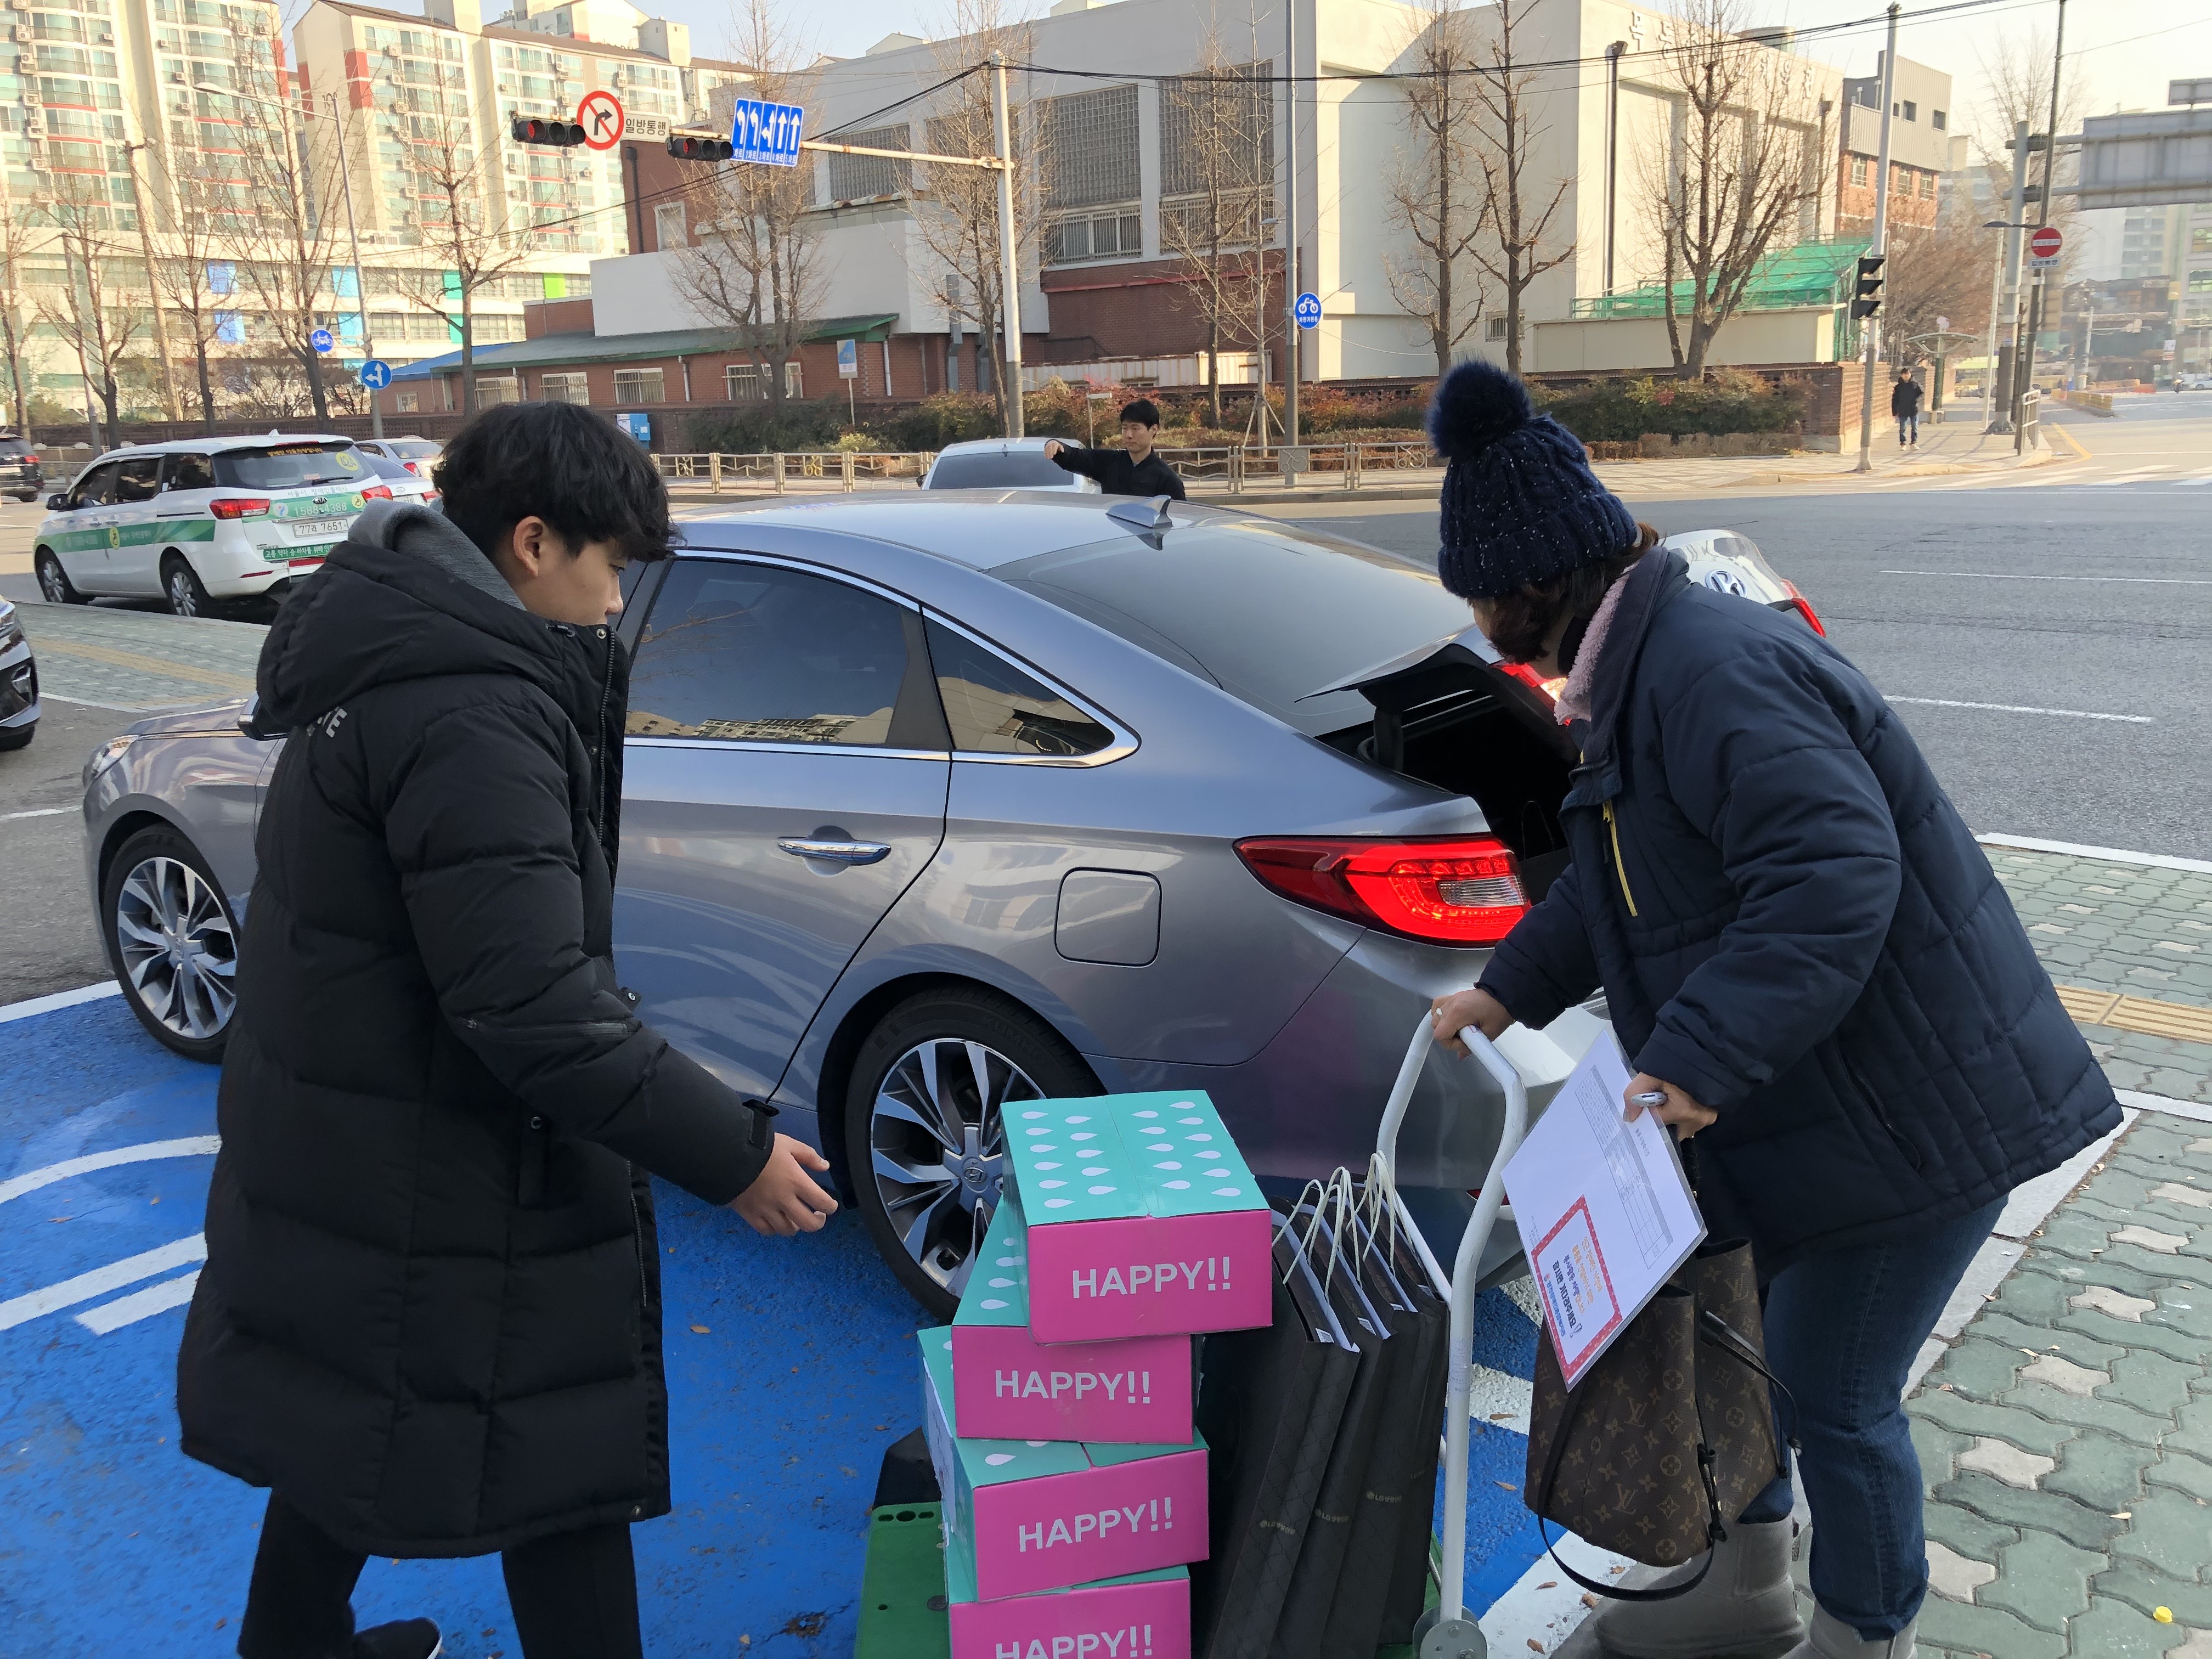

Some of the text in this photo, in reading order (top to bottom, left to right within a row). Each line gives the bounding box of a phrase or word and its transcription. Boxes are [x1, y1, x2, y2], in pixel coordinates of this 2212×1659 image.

[625, 118, 666, 136] 일방통행
[733, 148, 743, 159] 차로
[311, 486, 348, 495] 장애인콜택시
[294, 503, 347, 517] 1588-4388
[321, 522, 342, 531] 7651
[278, 549, 288, 557] 약자
[1073, 1257, 1231, 1299] HAPPY!!
[1552, 1259, 1564, 1285] 잠시만
[1562, 1253, 1575, 1283] 봉사활동
[995, 1370, 1150, 1404] HAPPY!!
[1019, 1497, 1172, 1552] HAPPY!!
[996, 1624, 1152, 1659] HAPPY!!
